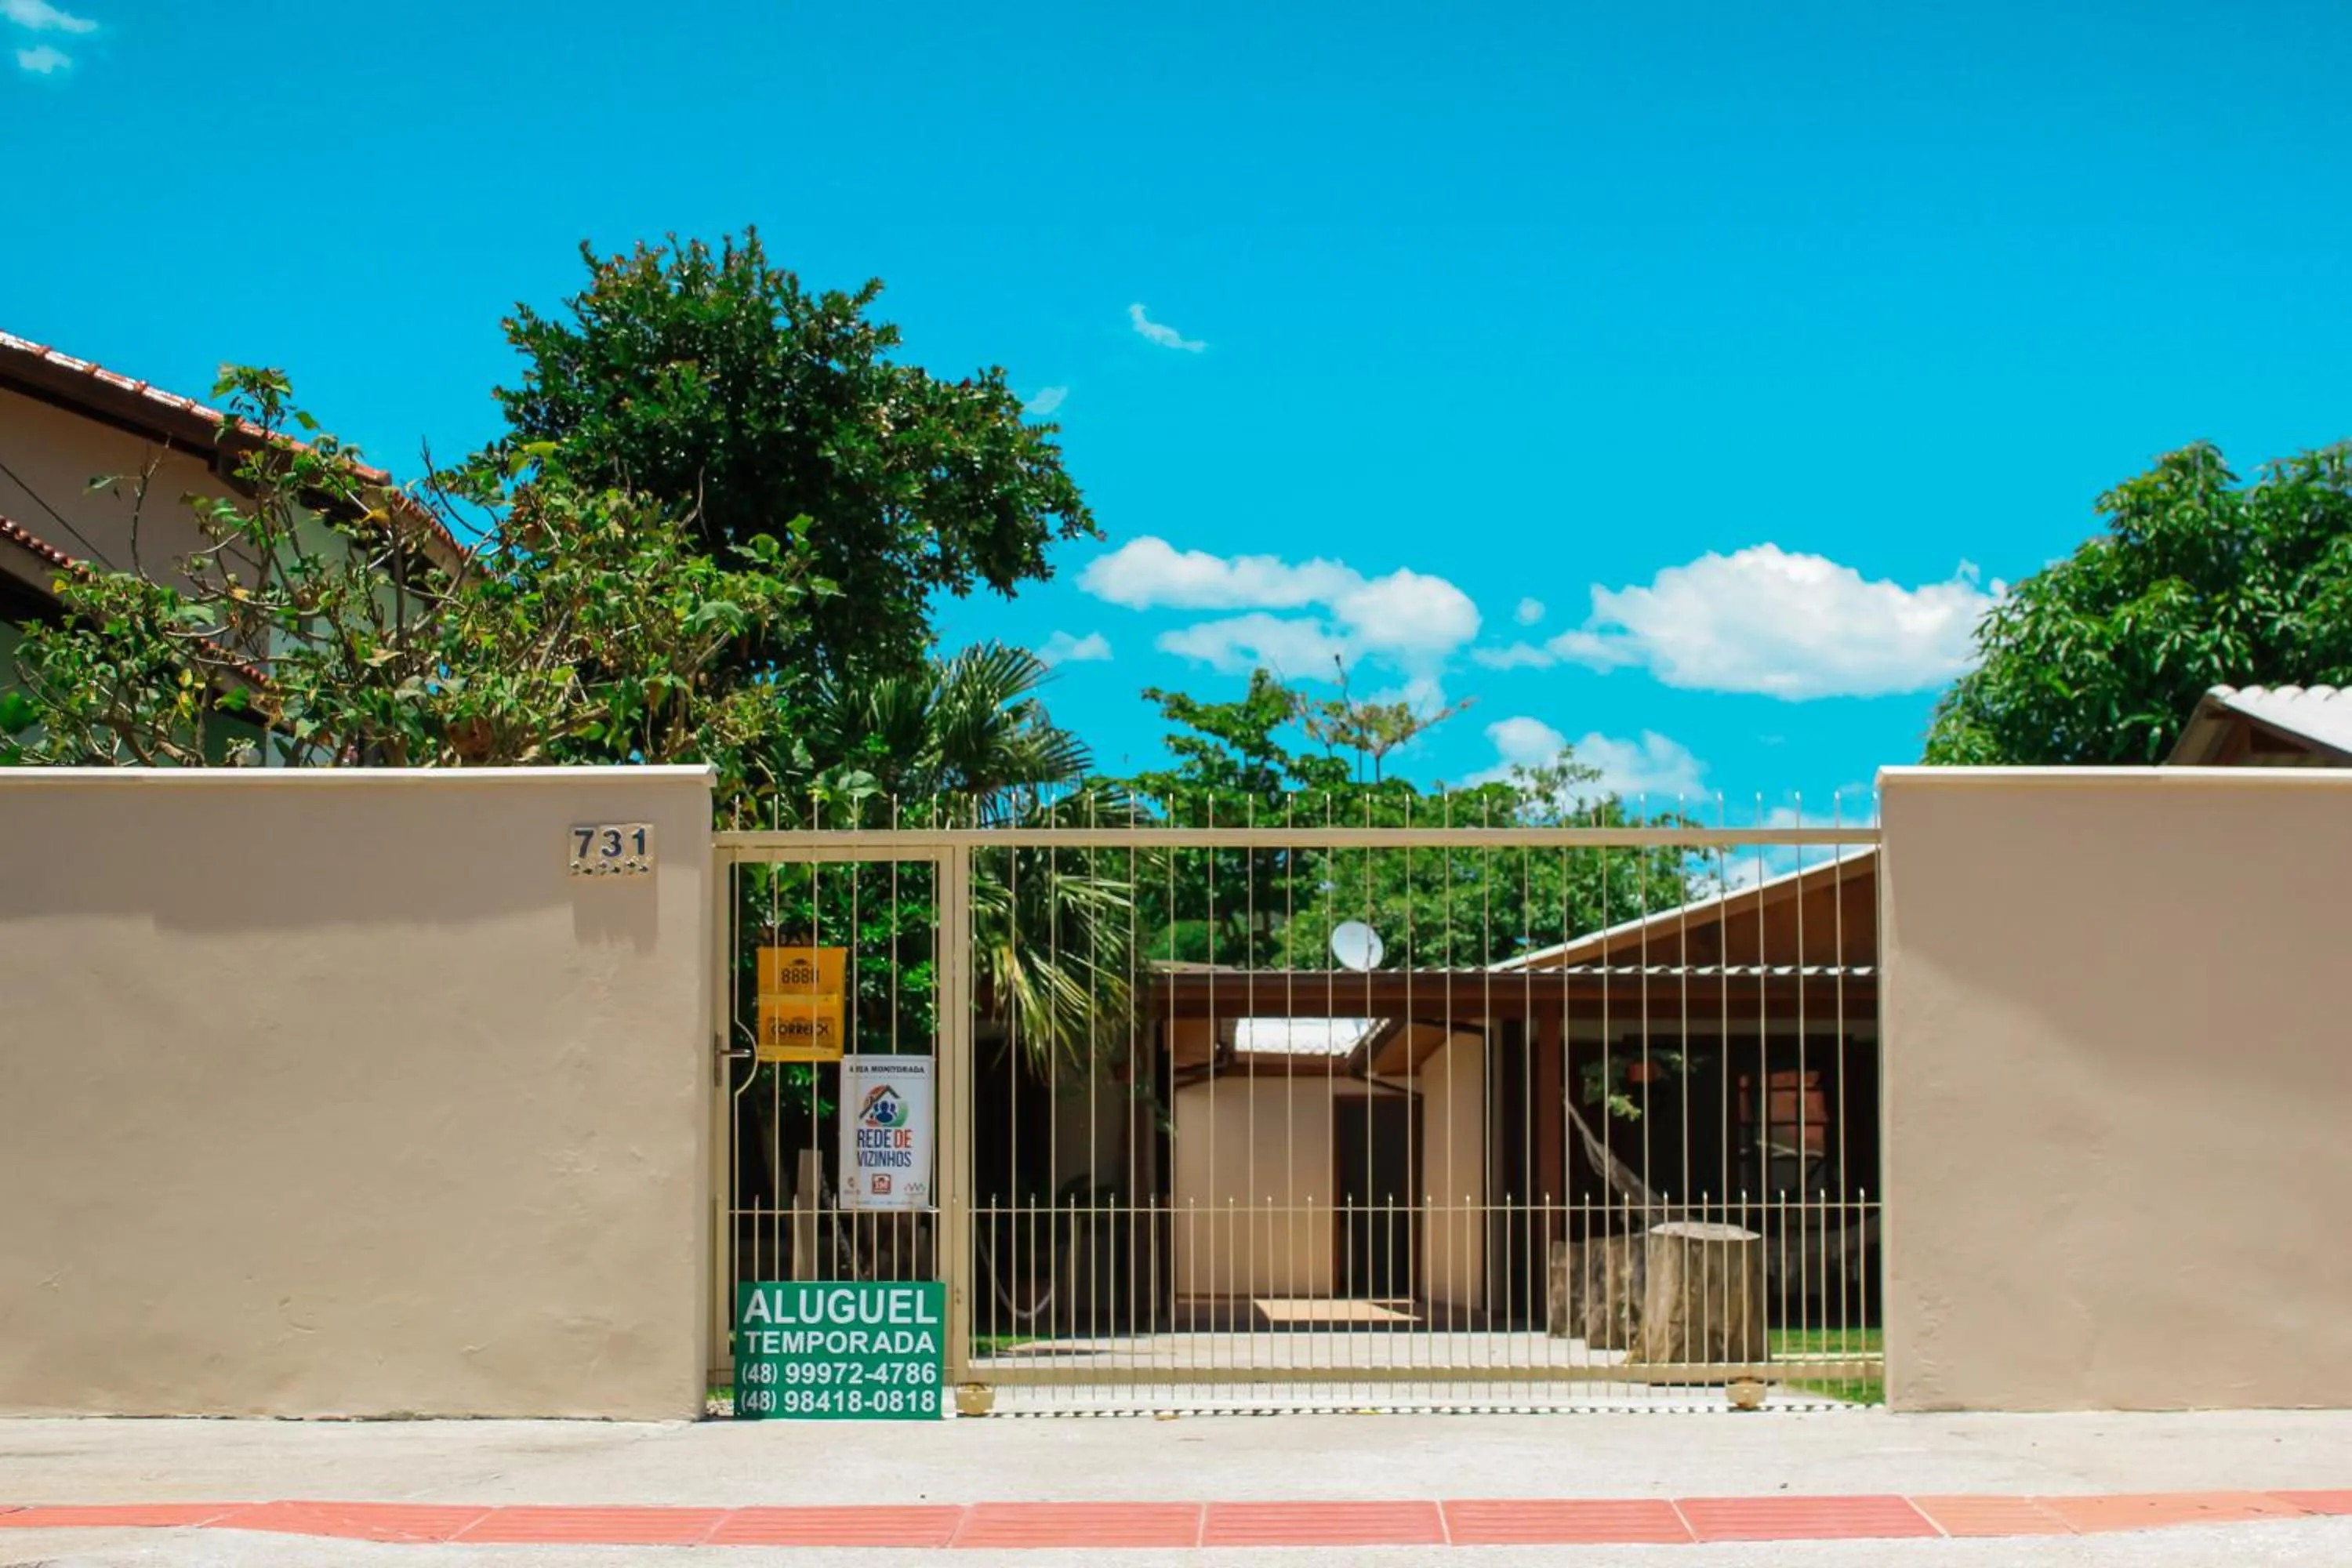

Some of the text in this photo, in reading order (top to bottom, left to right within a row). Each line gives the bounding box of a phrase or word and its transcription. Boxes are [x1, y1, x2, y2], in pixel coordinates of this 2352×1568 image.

[574, 828, 645, 858] 731
[857, 1129, 913, 1149] REDE DE
[856, 1150, 912, 1167] VIZINHOS
[742, 1288, 938, 1325] ALUGUEL
[743, 1330, 936, 1355] TEMPORADA
[742, 1362, 937, 1385] (48) 99972-4786
[740, 1390, 936, 1413] (48) 98418-0818
